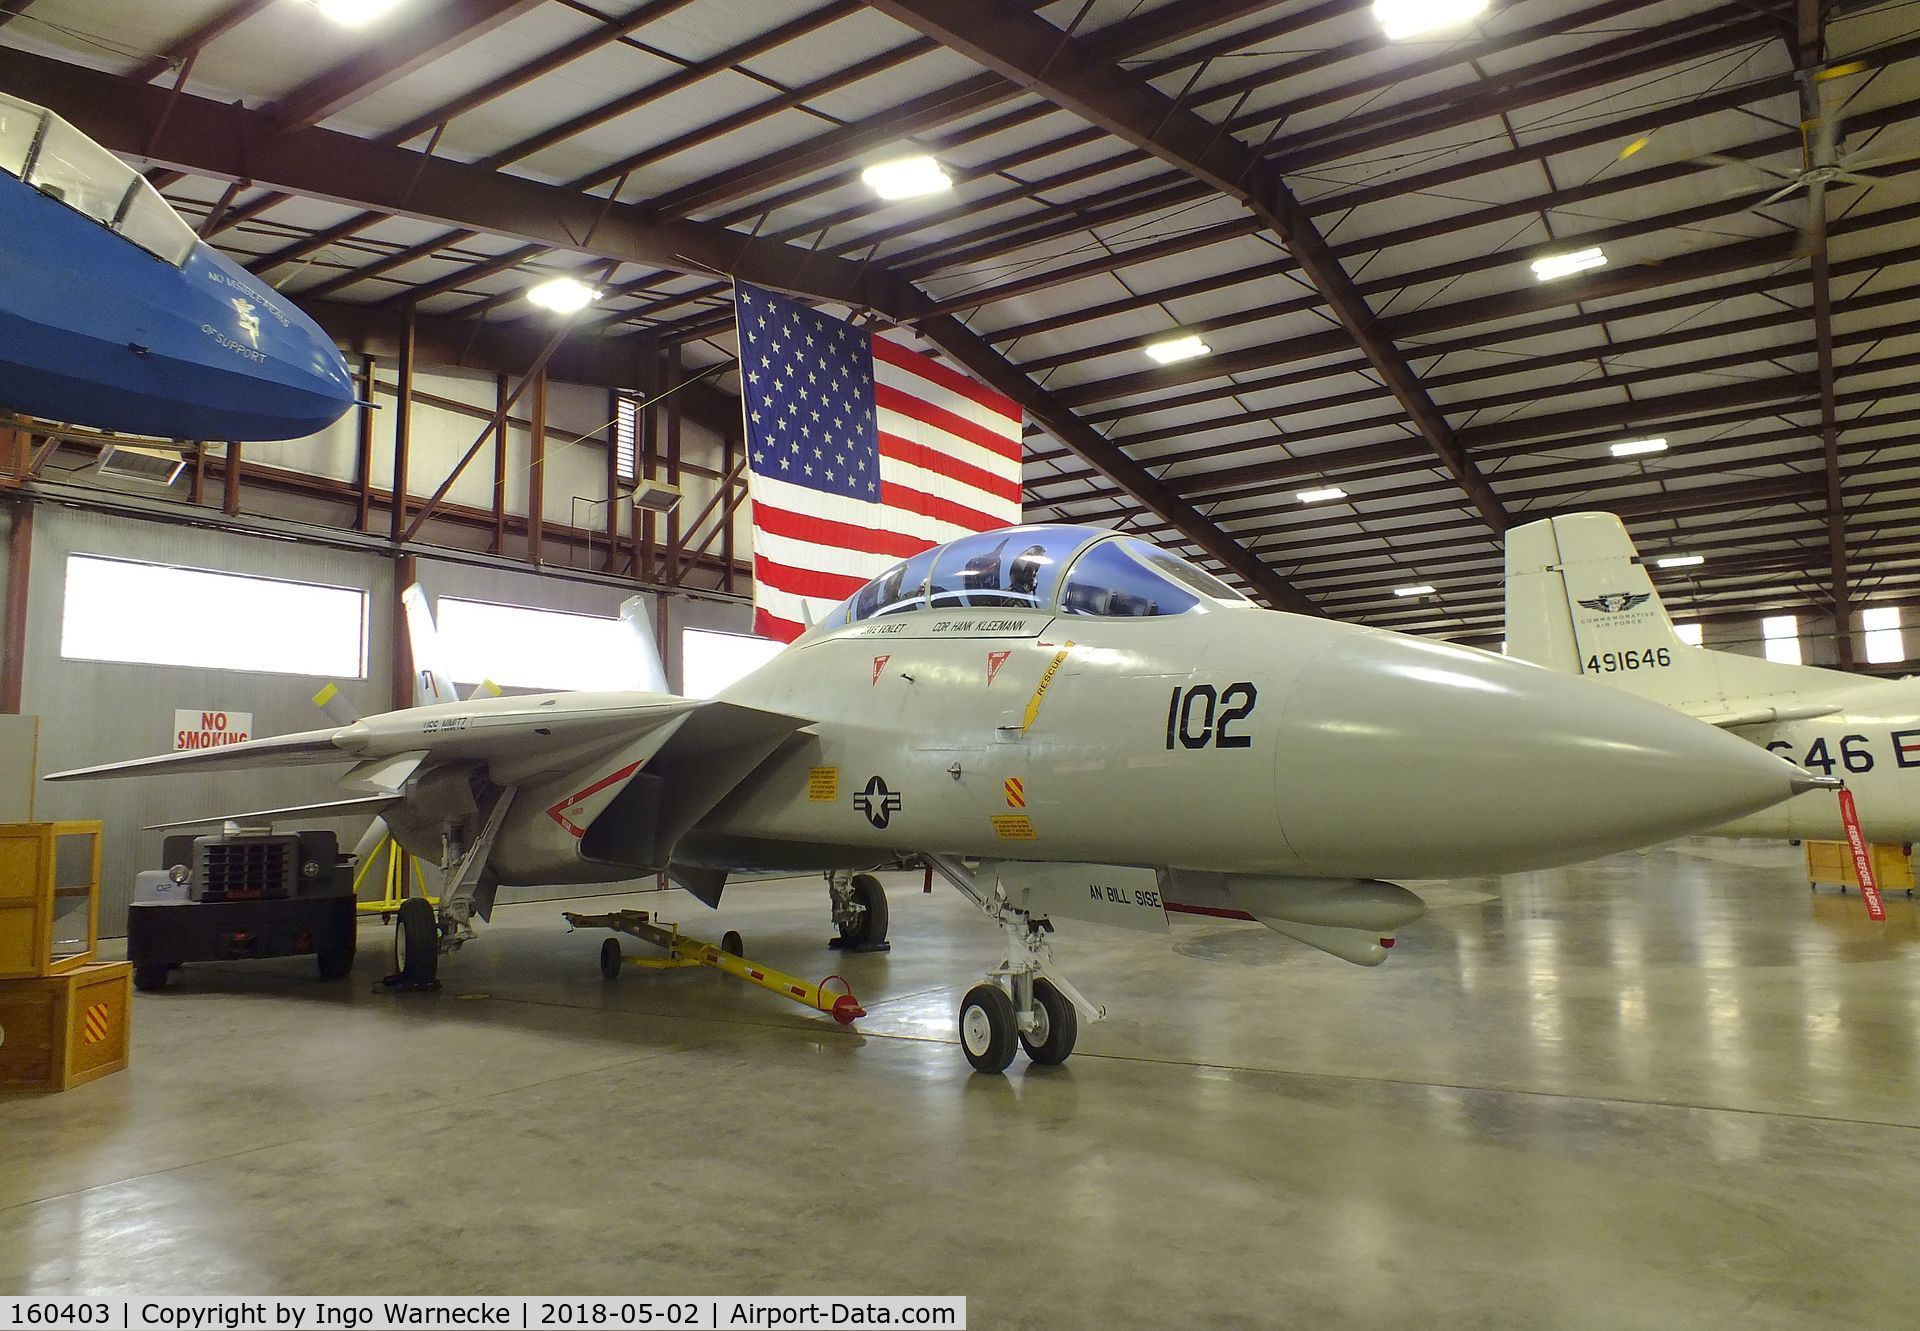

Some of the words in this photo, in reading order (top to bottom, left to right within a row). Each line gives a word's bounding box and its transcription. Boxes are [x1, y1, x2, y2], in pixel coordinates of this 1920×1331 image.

[208, 272, 224, 283] NO
[201, 324, 218, 335] OF
[215, 333, 267, 363] SUPPORT
[951, 620, 973, 632] HANK
[975, 620, 1027, 632] KLEEMANN
[1580, 612, 1655, 624] COMMEMORATIVE
[1587, 648, 1671, 673] 491646
[1037, 655, 1064, 696] RESCUE
[201, 712, 227, 731] NO
[1166, 682, 1257, 749] 102
[1848, 825, 1864, 855] REMOVE
[1857, 856, 1872, 886] BEFORE
[1090, 885, 1103, 900] AN
[1106, 886, 1131, 904] BILL
[1135, 890, 1161, 908] SISE
[1864, 886, 1881, 915] FLIGHT
